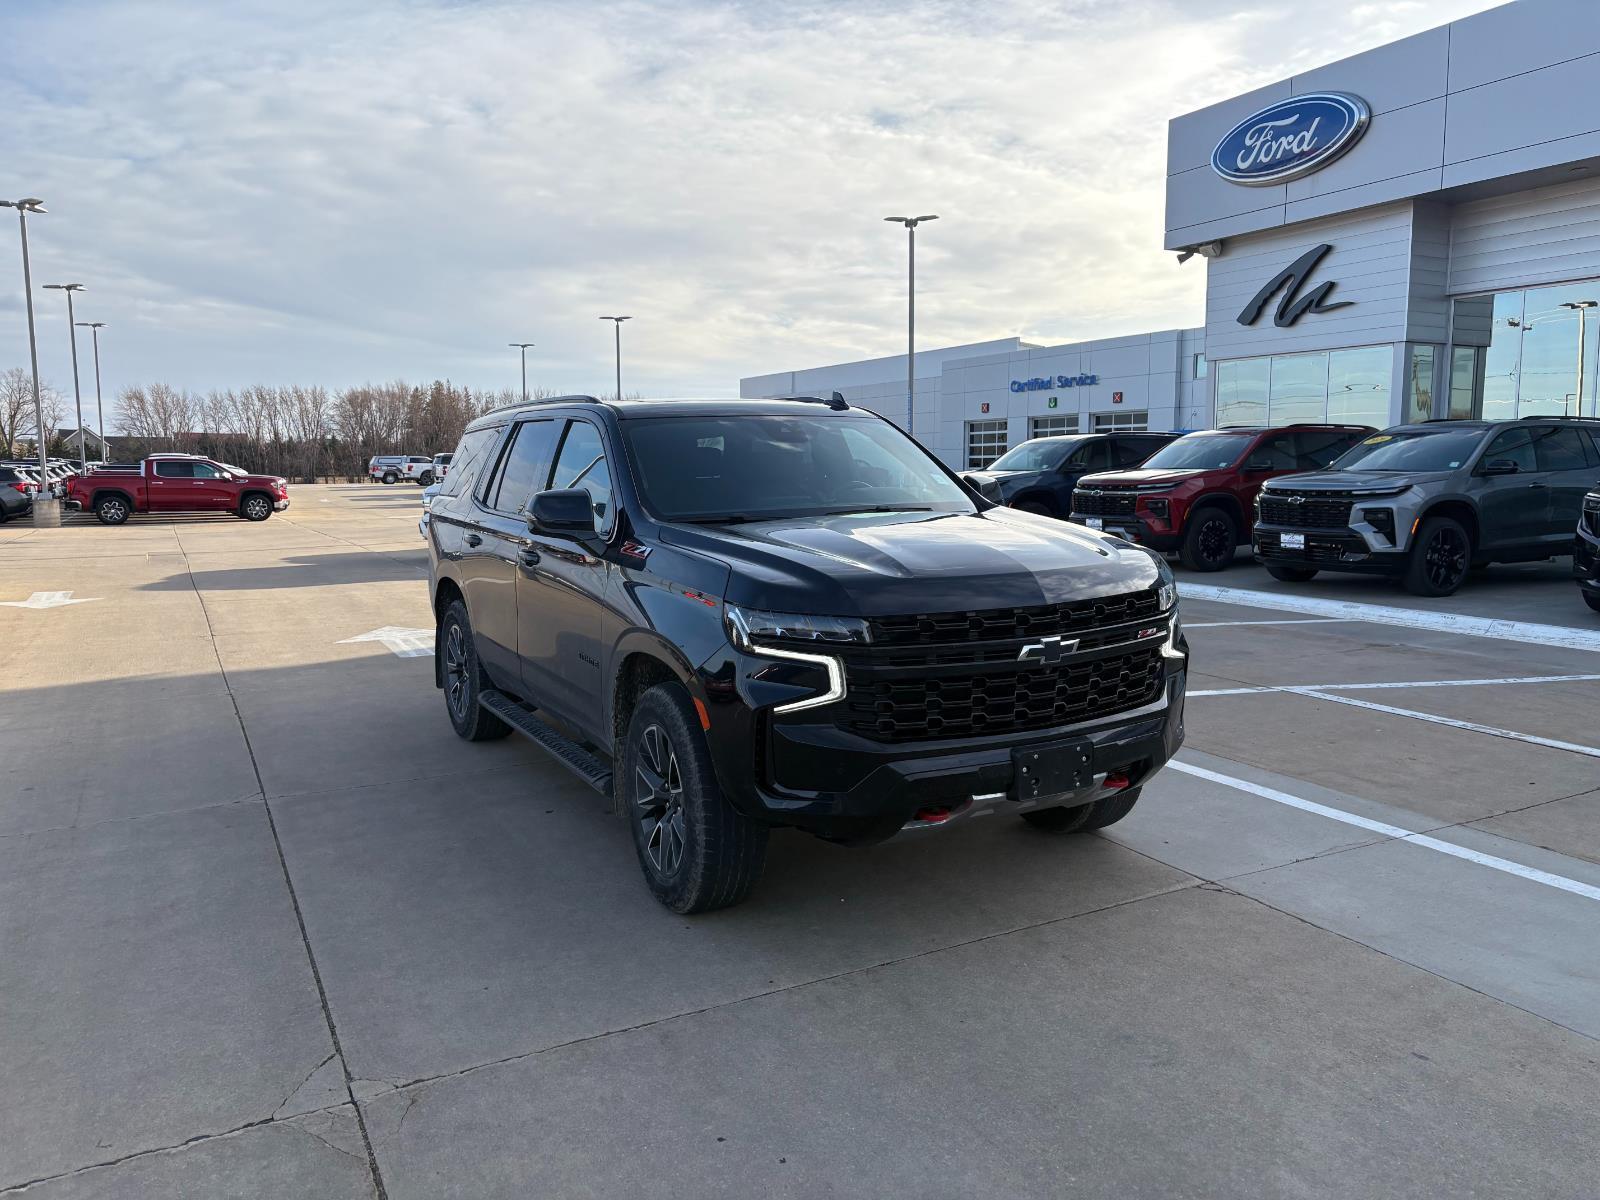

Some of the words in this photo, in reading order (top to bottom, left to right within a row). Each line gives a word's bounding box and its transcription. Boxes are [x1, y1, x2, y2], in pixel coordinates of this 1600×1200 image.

[1236, 113, 1321, 170] Ford
[1010, 376, 1053, 393] Certified
[1057, 373, 1098, 389] Service
